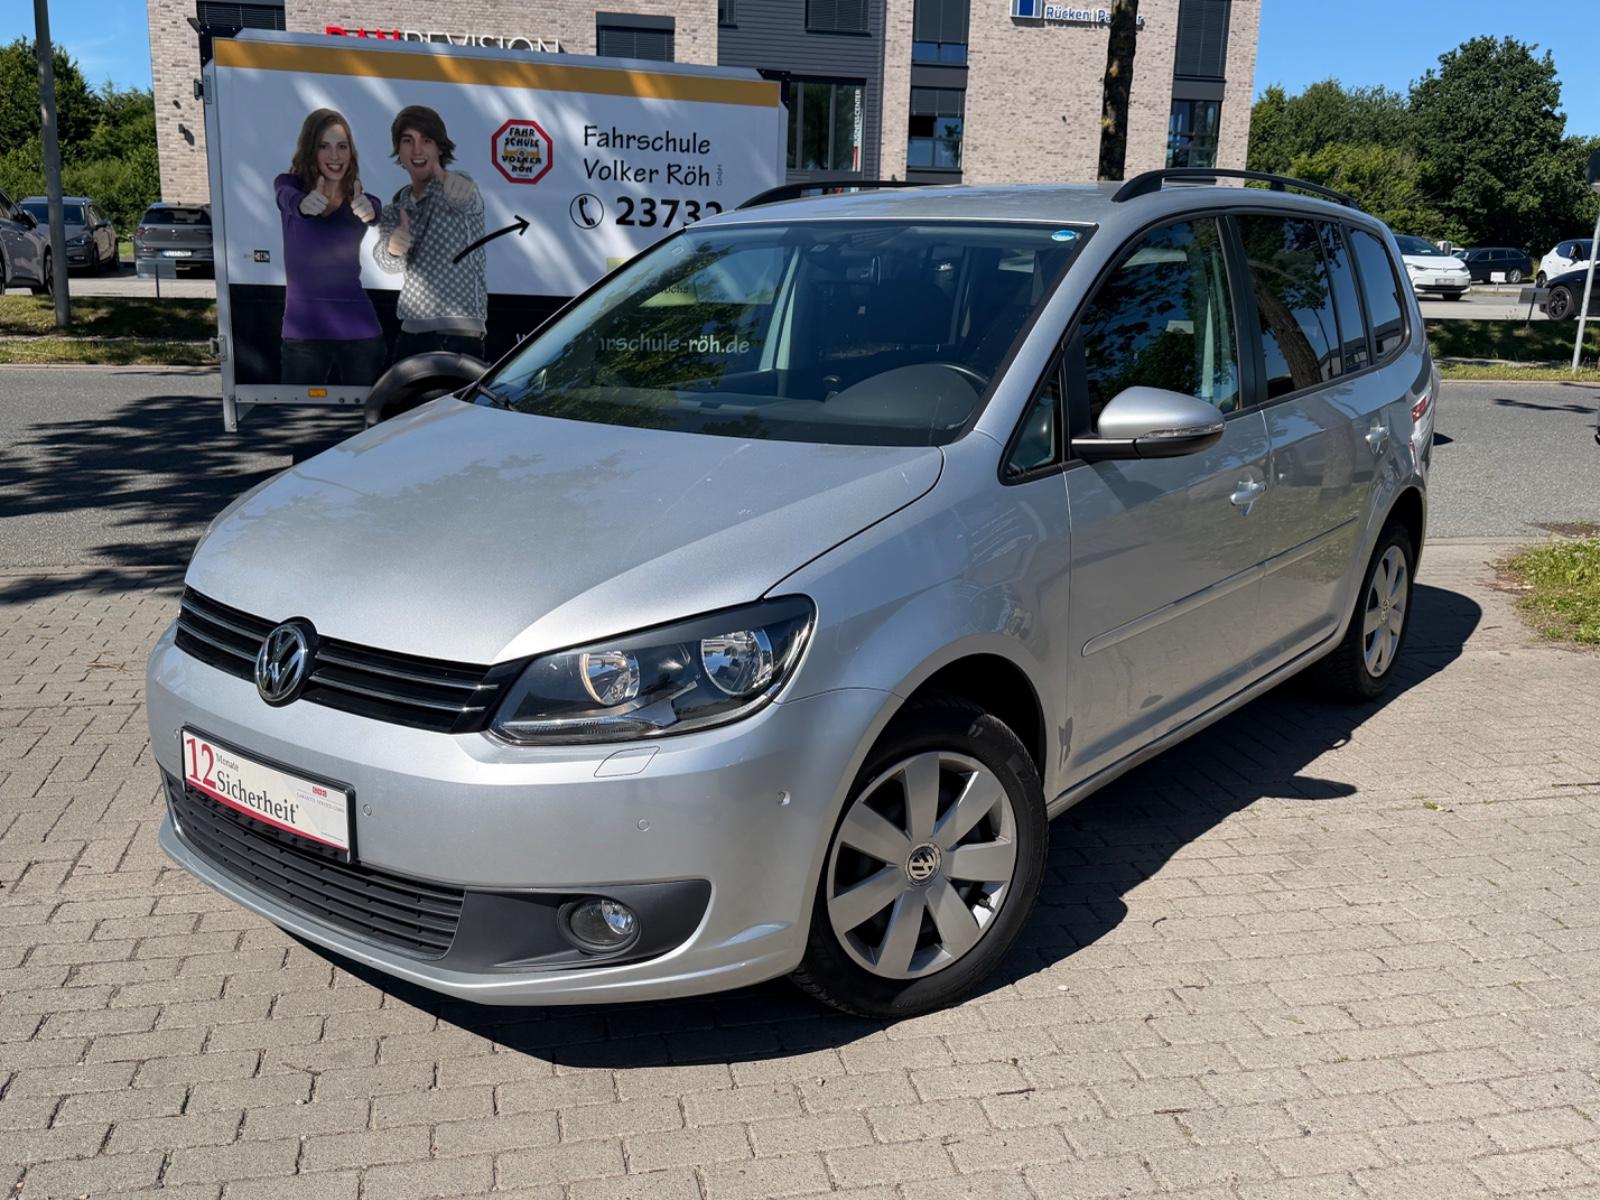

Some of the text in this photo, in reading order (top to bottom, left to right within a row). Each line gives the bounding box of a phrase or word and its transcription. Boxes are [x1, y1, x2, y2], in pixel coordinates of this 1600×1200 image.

[1046, 7, 1090, 20] Rücken
[584, 125, 711, 154] Fahrschule
[584, 158, 710, 187] Volker Röh
[186, 738, 217, 790] 12
[215, 753, 239, 772] Monate
